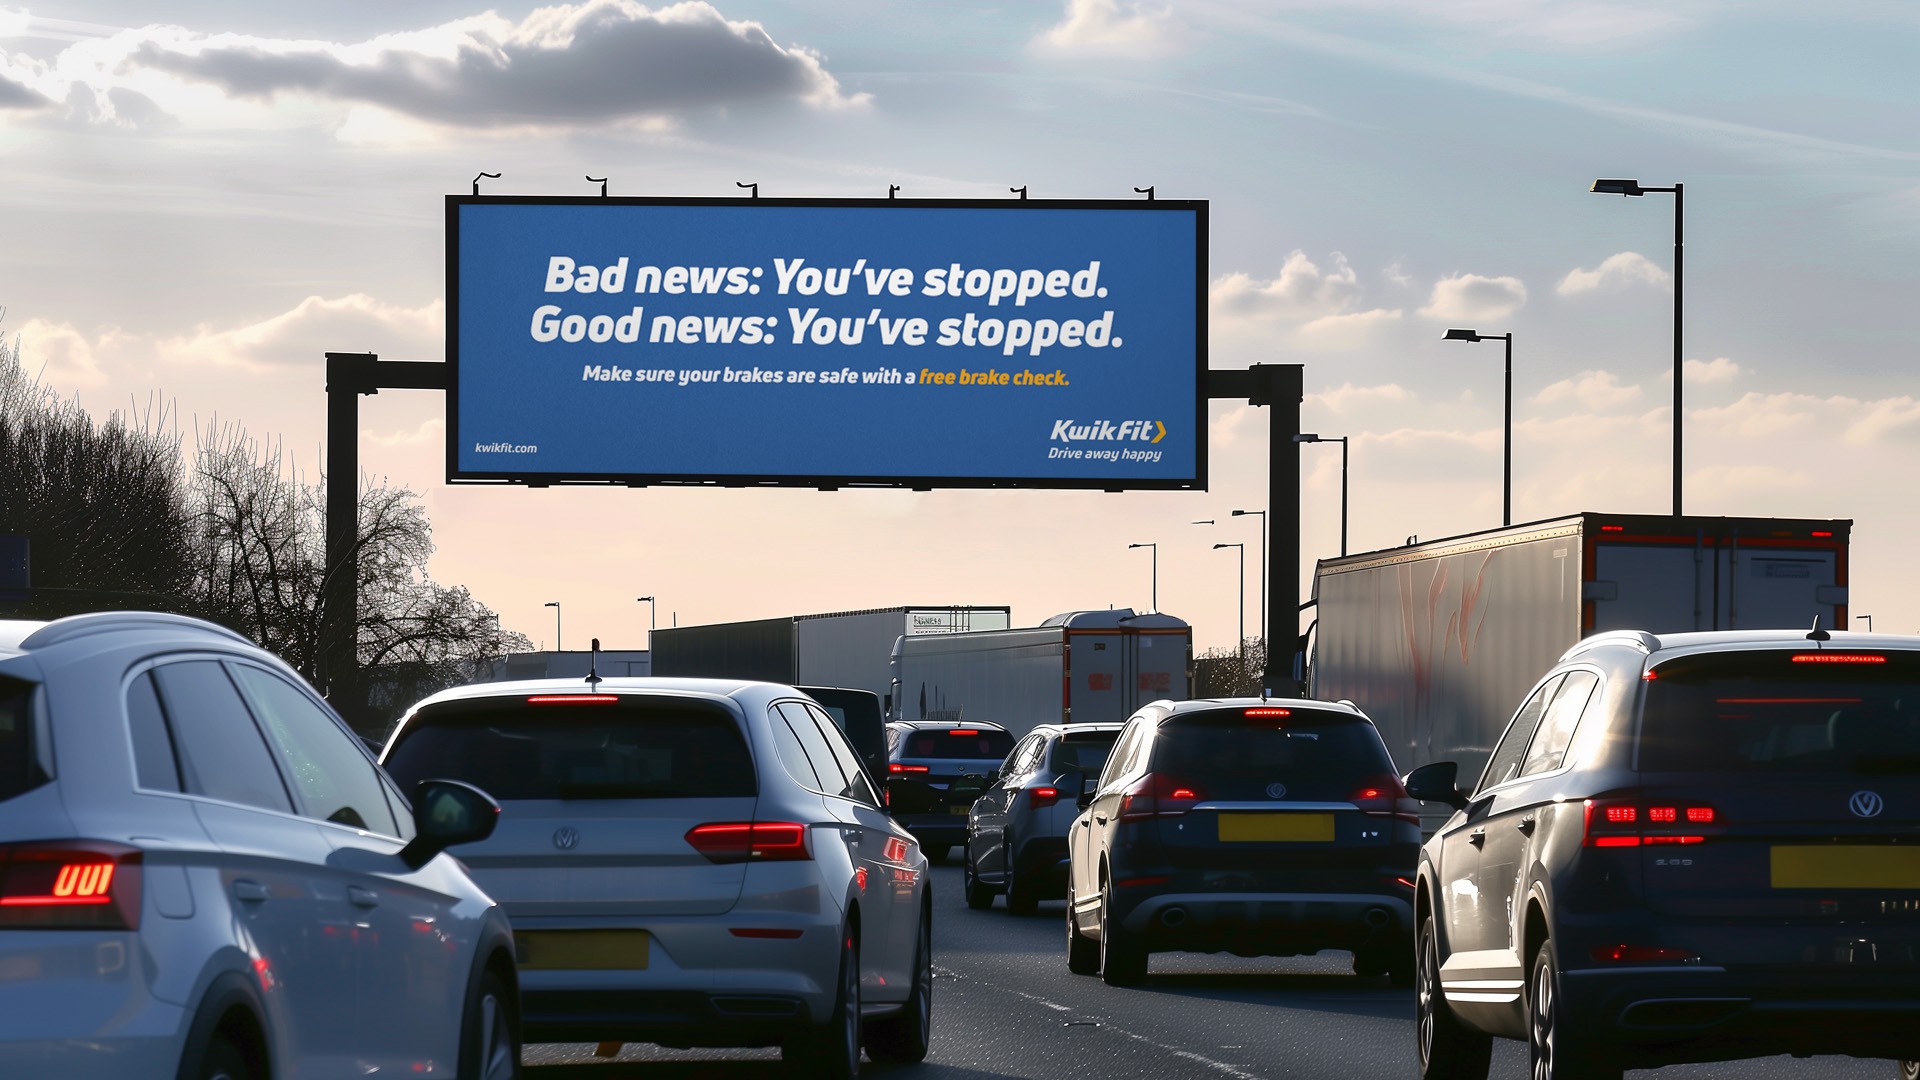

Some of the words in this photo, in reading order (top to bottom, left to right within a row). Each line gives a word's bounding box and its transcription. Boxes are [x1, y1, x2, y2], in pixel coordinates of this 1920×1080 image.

[544, 256, 630, 294] Bad
[634, 265, 764, 295] news:
[773, 258, 915, 297] You've
[921, 260, 1108, 307] stopped.
[530, 304, 644, 344] Good
[649, 315, 779, 345] news:
[787, 307, 929, 347] You've
[935, 310, 1123, 357] stopped.
[582, 364, 633, 382] Make
[634, 369, 676, 383] sure
[678, 369, 722, 387] your
[722, 366, 784, 384] brakes
[786, 370, 817, 384] are
[818, 367, 859, 384] safe
[861, 366, 902, 385] with
[904, 371, 917, 385] a
[918, 367, 957, 385] free
[958, 368, 1011, 386] brake
[1012, 369, 1070, 386] check.
[475, 442, 538, 454] kwikfit.com
[1047, 446, 1083, 459] Drive
[1084, 450, 1120, 462] away
[1121, 448, 1163, 463] happy
